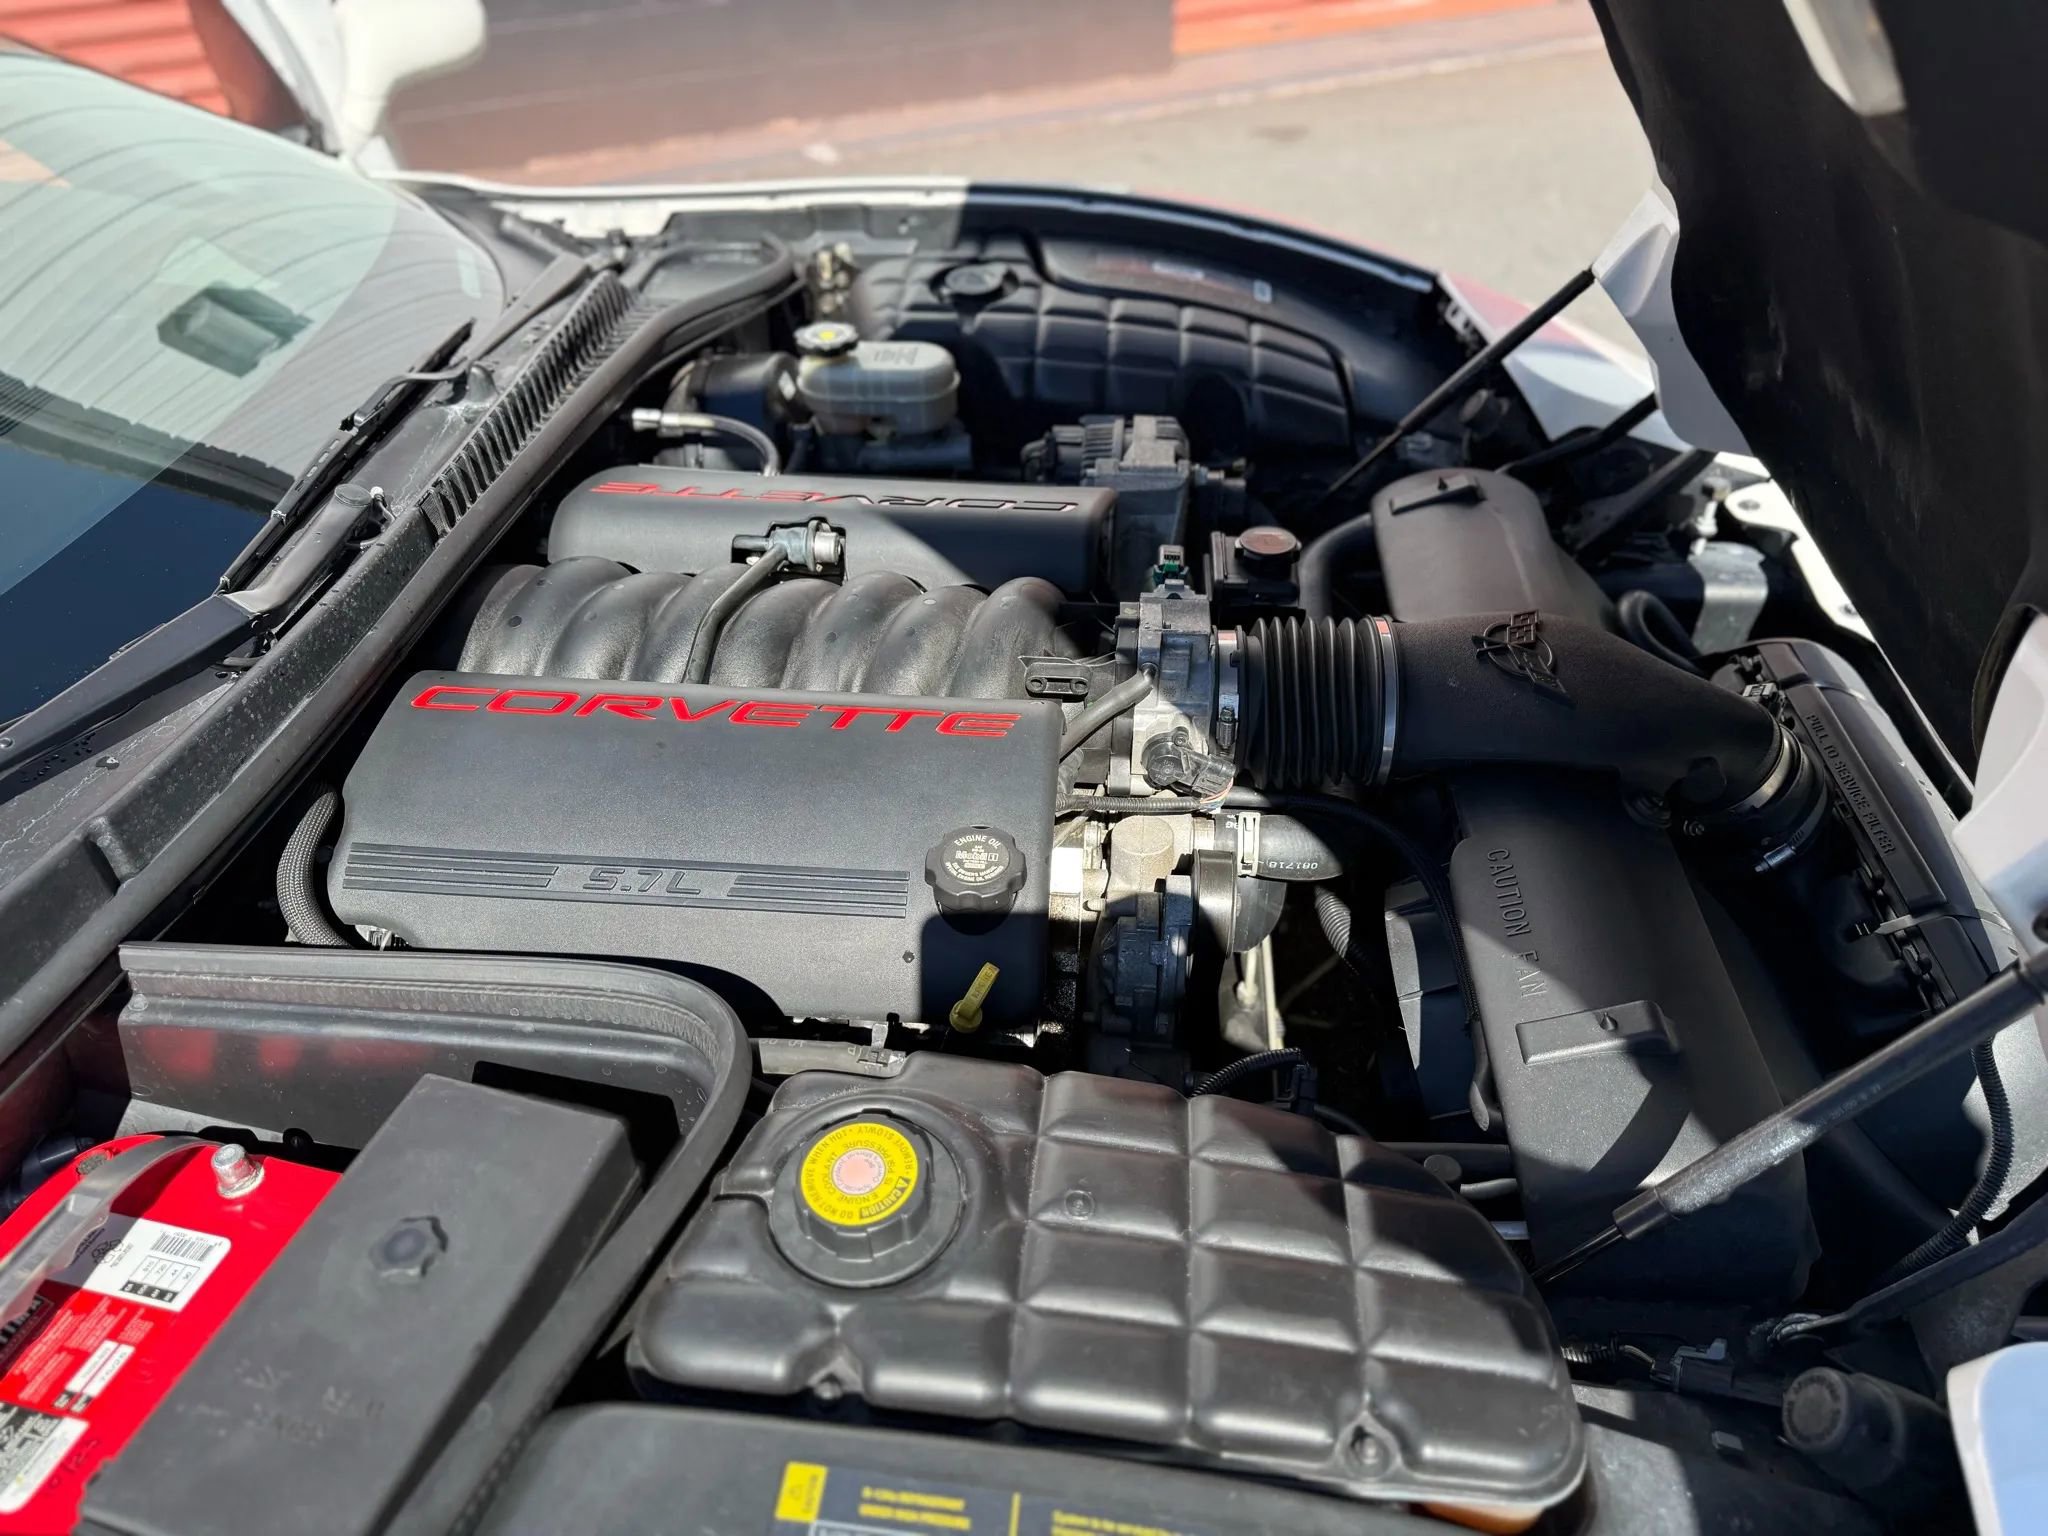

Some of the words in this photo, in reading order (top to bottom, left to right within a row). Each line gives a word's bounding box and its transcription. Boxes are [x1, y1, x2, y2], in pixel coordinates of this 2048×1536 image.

[590, 481, 1079, 511] CORVETTE
[410, 685, 1022, 738] CORVETTE
[1806, 714, 1829, 744] PULL
[1823, 744, 1840, 760] TO
[1834, 760, 1871, 811] SERVICE
[1862, 812, 1897, 856] FILTER
[954, 834, 988, 846] ENGINE
[988, 838, 1001, 850] OIL
[1267, 860, 1318, 871] 081718
[582, 866, 702, 896] 5.7L
[1487, 848, 1533, 938] CAUTION
[1511, 950, 1548, 998] FAN
[829, 1128, 849, 1142] HOT
[857, 1126, 895, 1140] SLOWLY
[809, 1142, 830, 1165] WHEN
[842, 1139, 891, 1159] PRESSURE
[892, 1138, 914, 1171] REMOVE
[805, 1168, 822, 1204] REMOVE
[822, 1151, 839, 1195] COOLANT
[819, 1201, 839, 1215] NOT
[837, 1193, 880, 1205] ENGINE
[861, 1188, 903, 1218] CAUTION
[840, 1210, 854, 1219] DO
